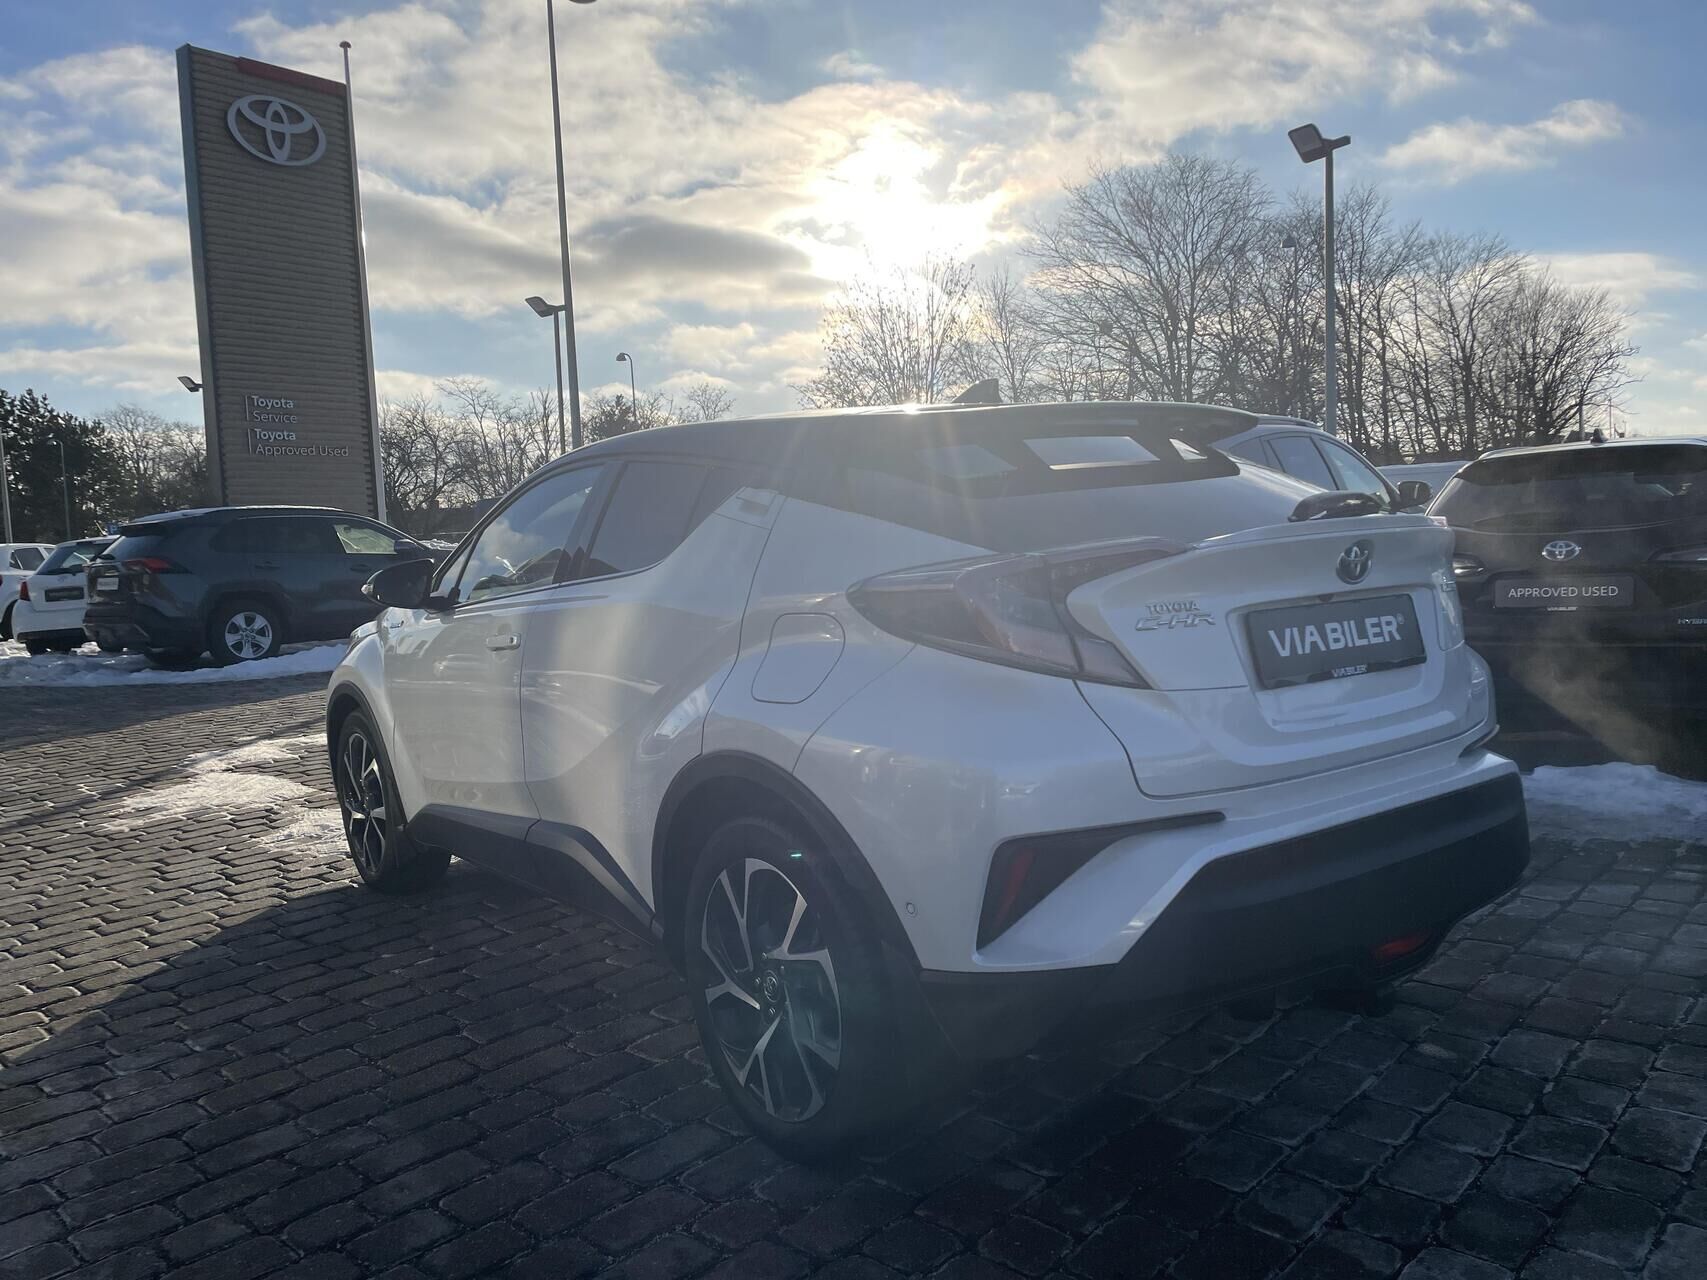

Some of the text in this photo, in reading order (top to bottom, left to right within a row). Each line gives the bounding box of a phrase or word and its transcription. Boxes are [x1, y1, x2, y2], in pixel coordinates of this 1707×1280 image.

[252, 396, 294, 409] Toyota
[253, 411, 298, 423] Service
[254, 428, 296, 442] Toyota
[256, 444, 349, 457] Approved Used
[1508, 586, 1619, 598] APPROVED USED
[1145, 601, 1200, 615] TOYOTA
[1135, 613, 1216, 631] C-HR
